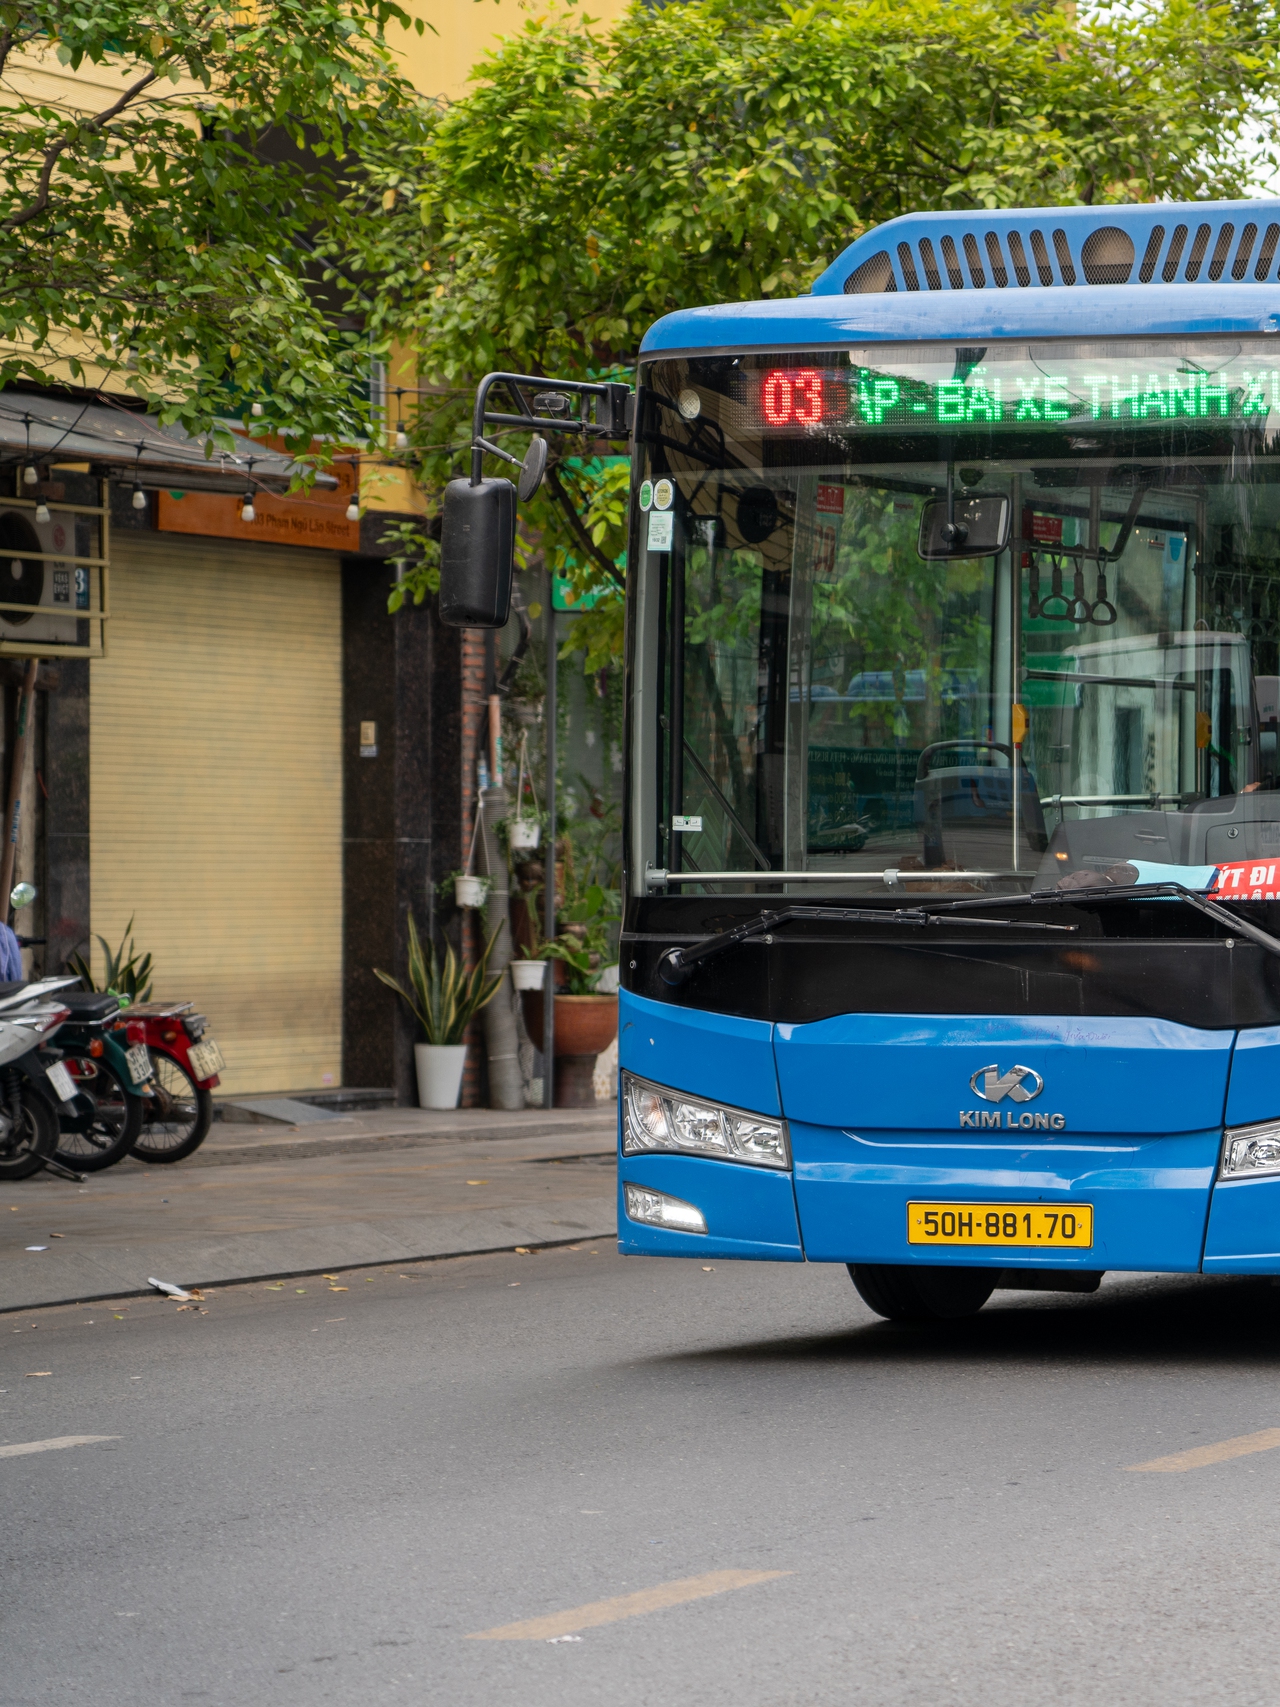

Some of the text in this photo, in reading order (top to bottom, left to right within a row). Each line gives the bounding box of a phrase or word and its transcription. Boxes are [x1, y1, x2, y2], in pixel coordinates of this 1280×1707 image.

[764, 371, 823, 425] 03
[1015, 376, 1070, 422] XE
[1249, 865, 1276, 886] ĐI
[959, 1111, 1066, 1129] KIM LONG
[924, 1211, 1076, 1239] 50H-881.70
